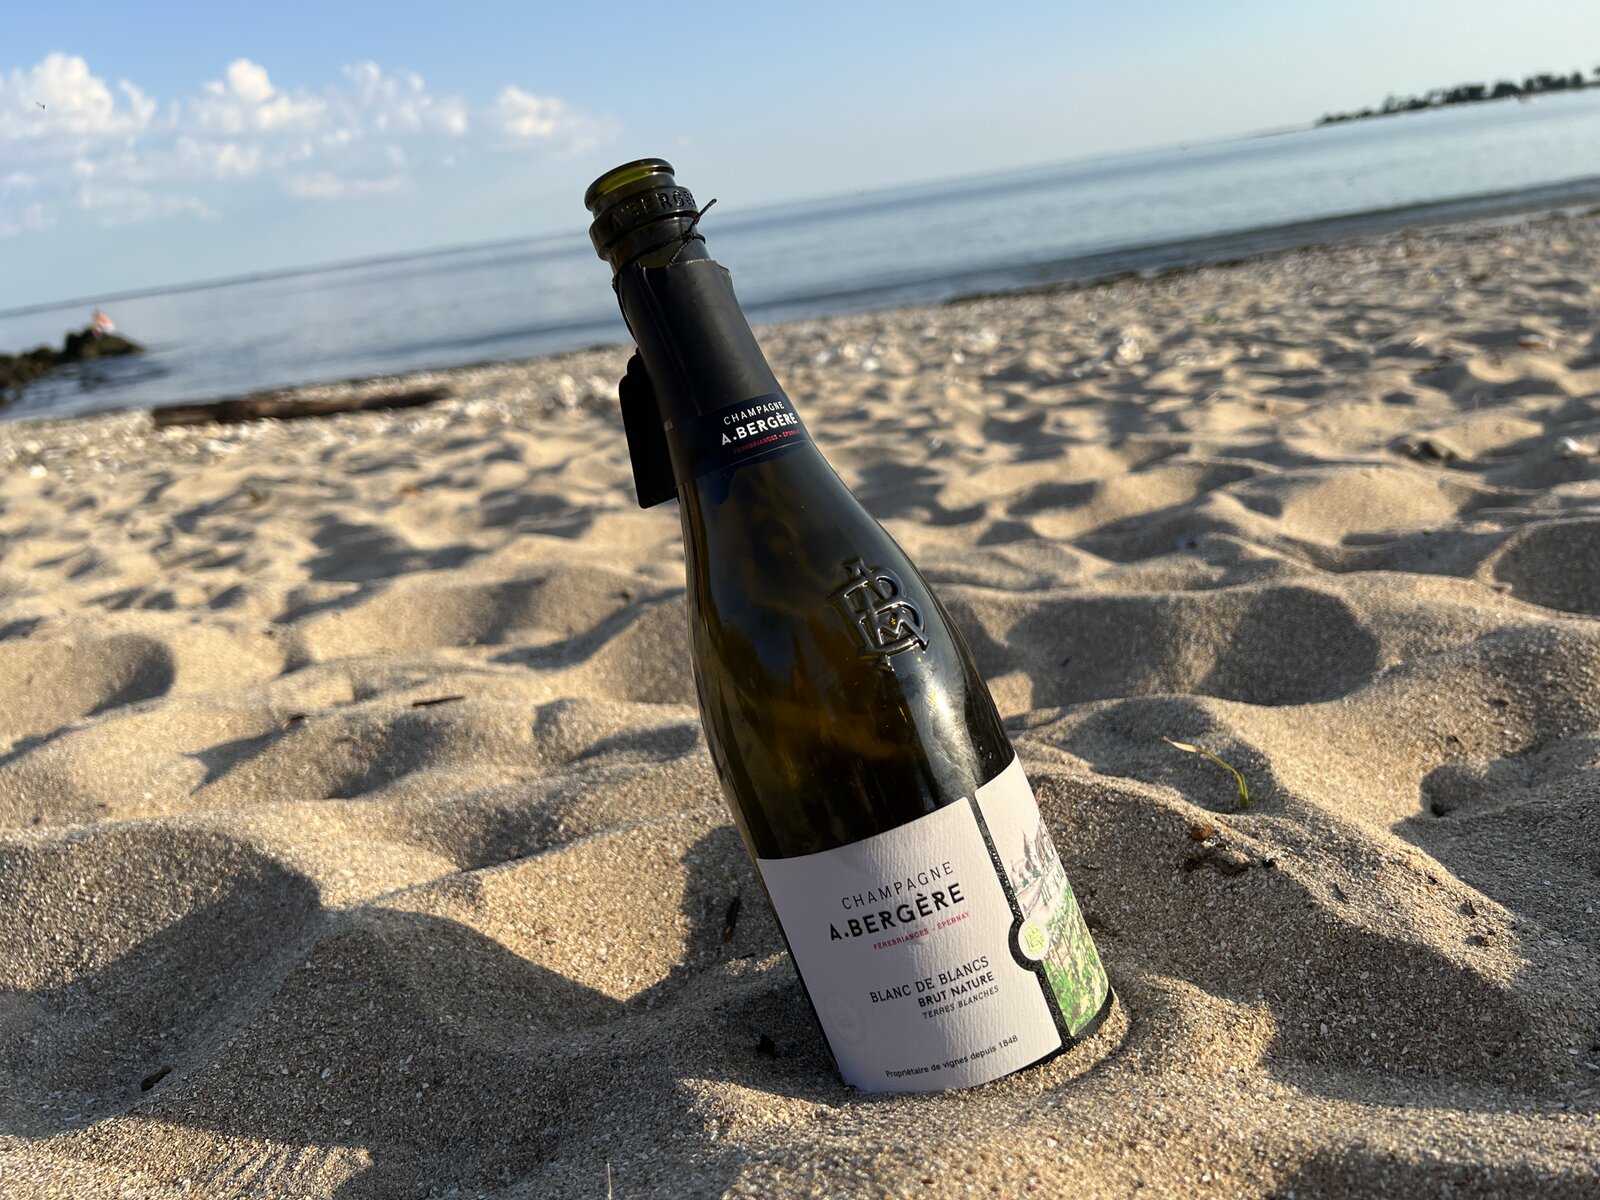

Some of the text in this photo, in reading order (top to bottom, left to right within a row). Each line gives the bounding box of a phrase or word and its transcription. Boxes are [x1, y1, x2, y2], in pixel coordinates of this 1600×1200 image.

[723, 401, 785, 426] CHAMPAGNE
[842, 861, 954, 910] CHAMPAGNE
[869, 955, 989, 1003] BLANC DE BLANCS
[917, 971, 995, 1008] BRUT NATURE
[922, 985, 999, 1020] TERRES BLANCHES
[885, 1034, 1019, 1078] Propriétaire de vignes depuis 1848
